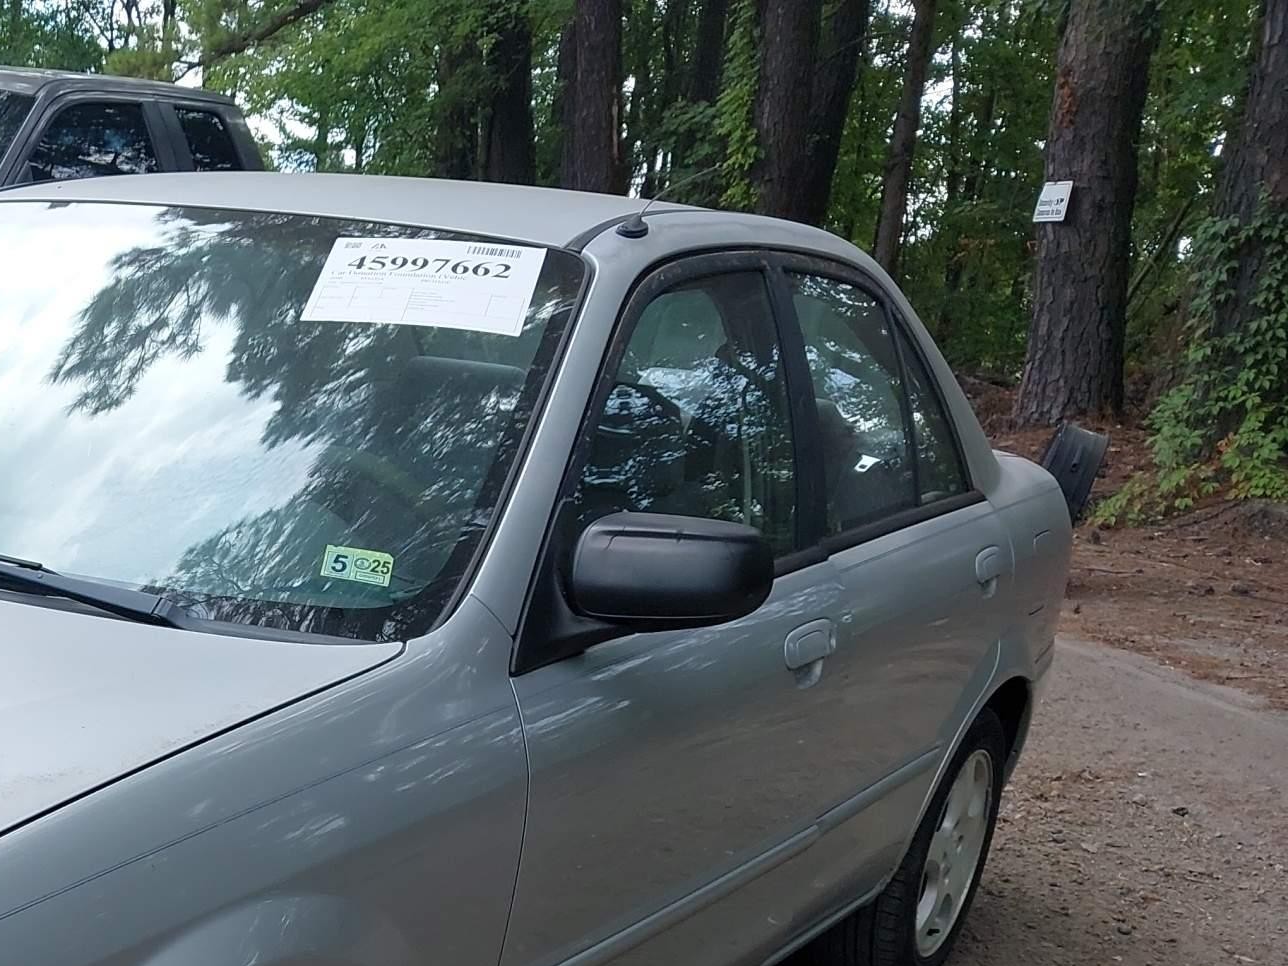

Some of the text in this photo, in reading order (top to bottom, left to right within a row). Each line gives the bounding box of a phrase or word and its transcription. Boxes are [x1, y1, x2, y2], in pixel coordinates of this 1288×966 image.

[347, 255, 512, 279] 45997662
[331, 554, 391, 575] 5 25
